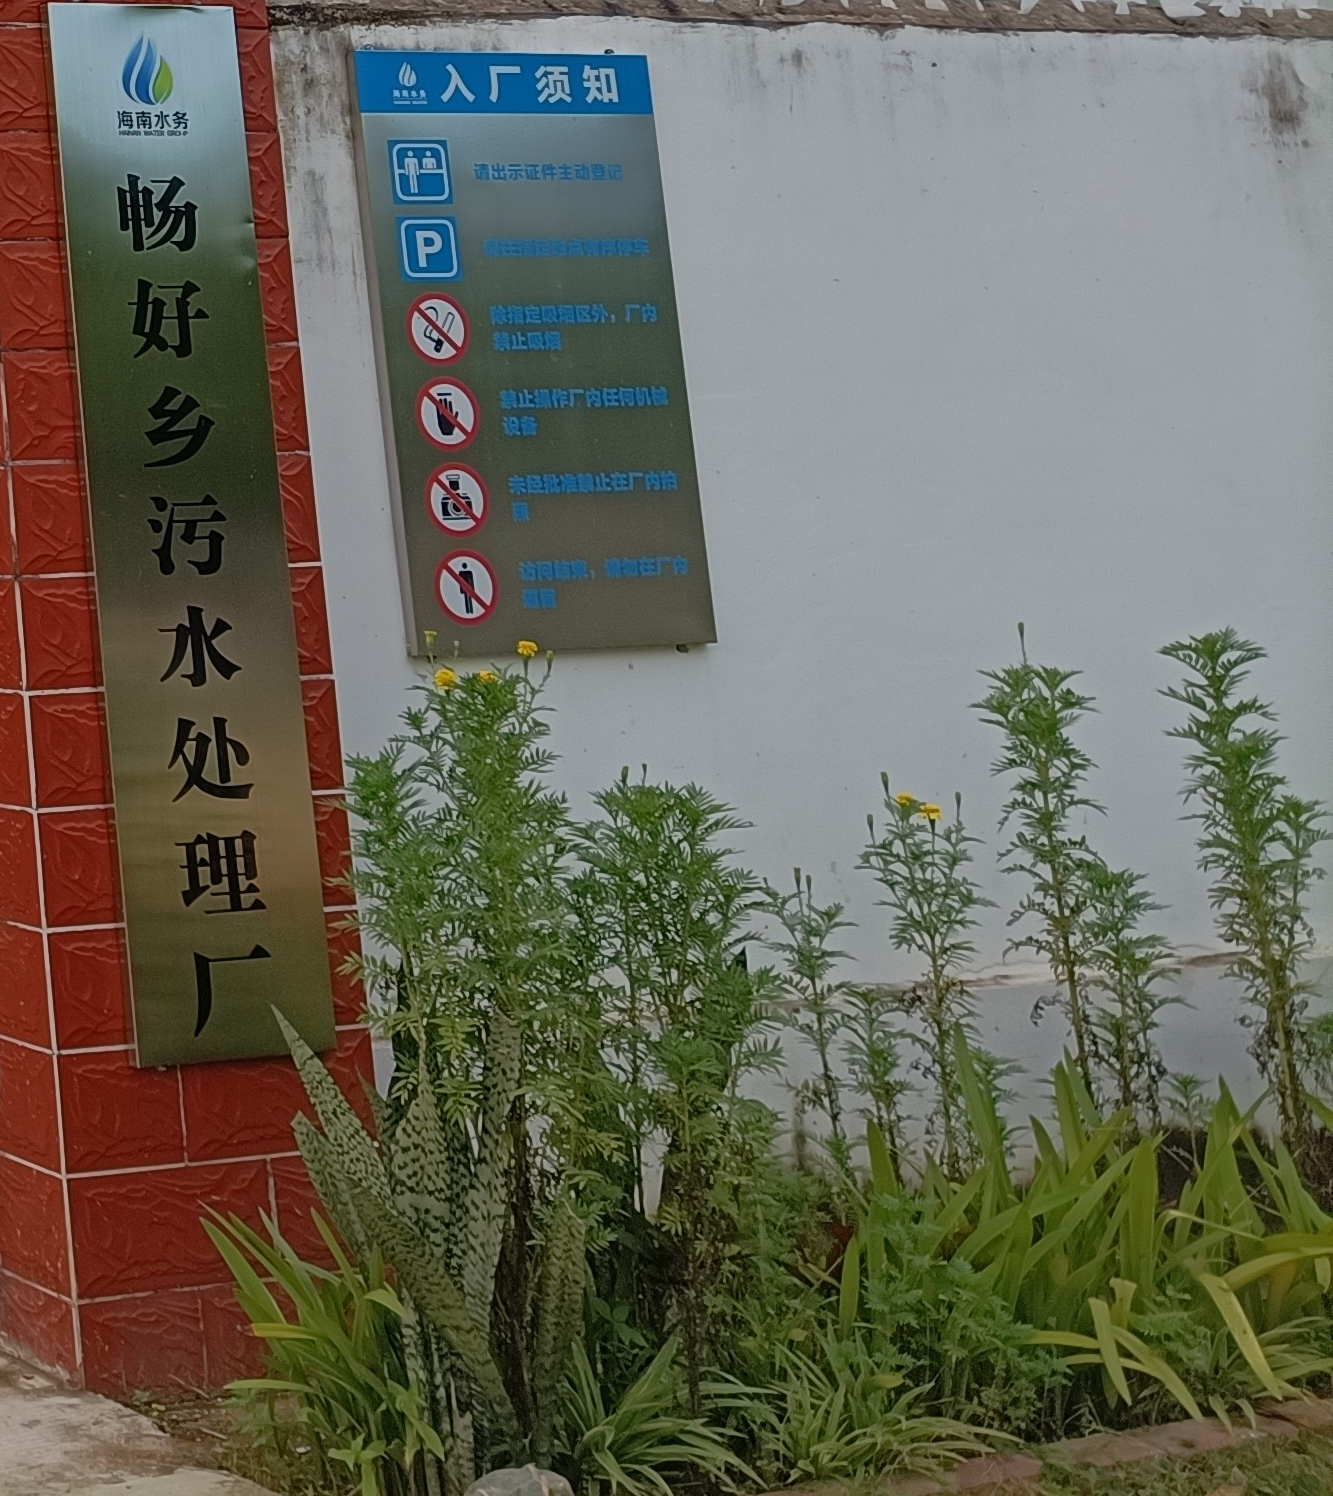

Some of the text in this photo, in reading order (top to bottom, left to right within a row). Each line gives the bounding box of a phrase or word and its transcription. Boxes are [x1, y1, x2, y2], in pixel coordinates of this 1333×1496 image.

[440, 63, 620, 104] 入厂须知
[116, 110, 190, 130] 海南水务
[473, 162, 623, 182] 请出示证件主动登记
[415, 230, 443, 268] P
[116, 173, 272, 1038] 畅好乡污水处理厂
